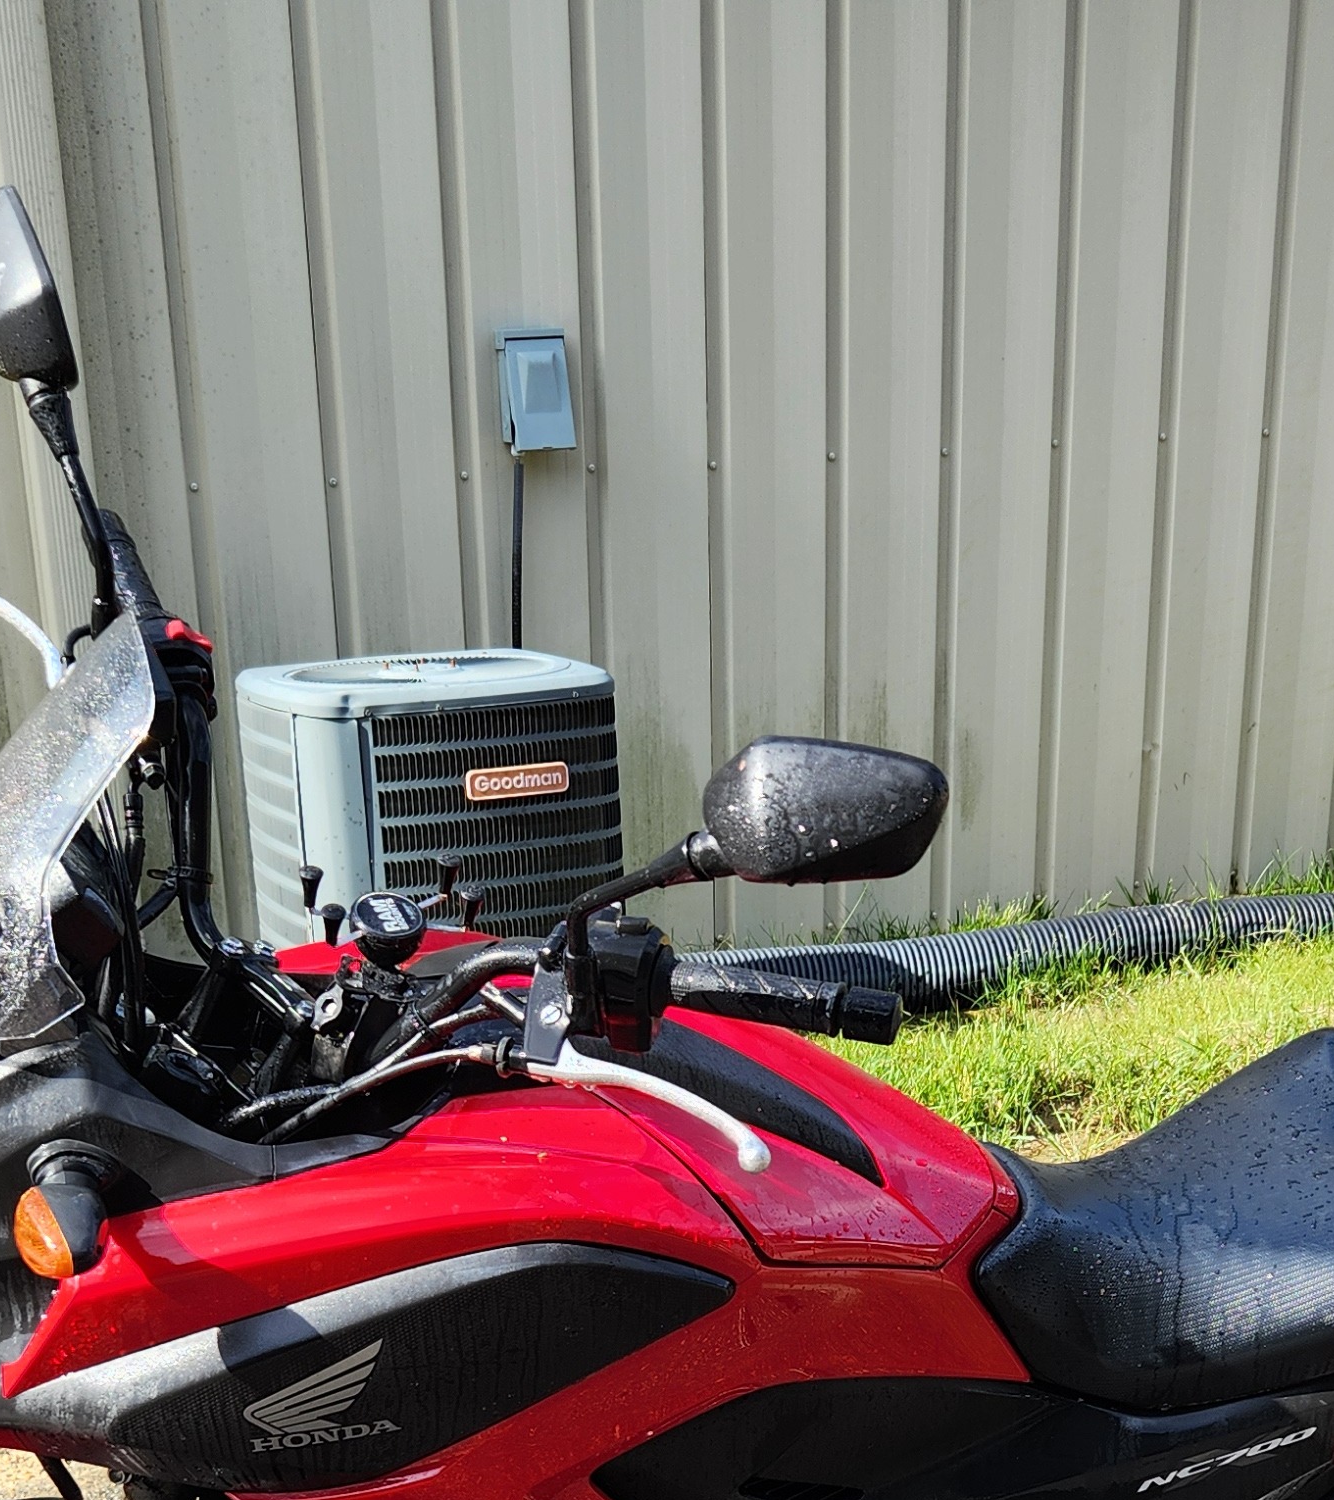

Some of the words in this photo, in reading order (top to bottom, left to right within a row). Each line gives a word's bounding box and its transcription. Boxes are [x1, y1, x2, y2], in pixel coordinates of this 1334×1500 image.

[474, 772, 562, 792] Goodman
[369, 898, 402, 932] RAM
[250, 1419, 402, 1453] HONDA
[1136, 1426, 1317, 1493] NC700
